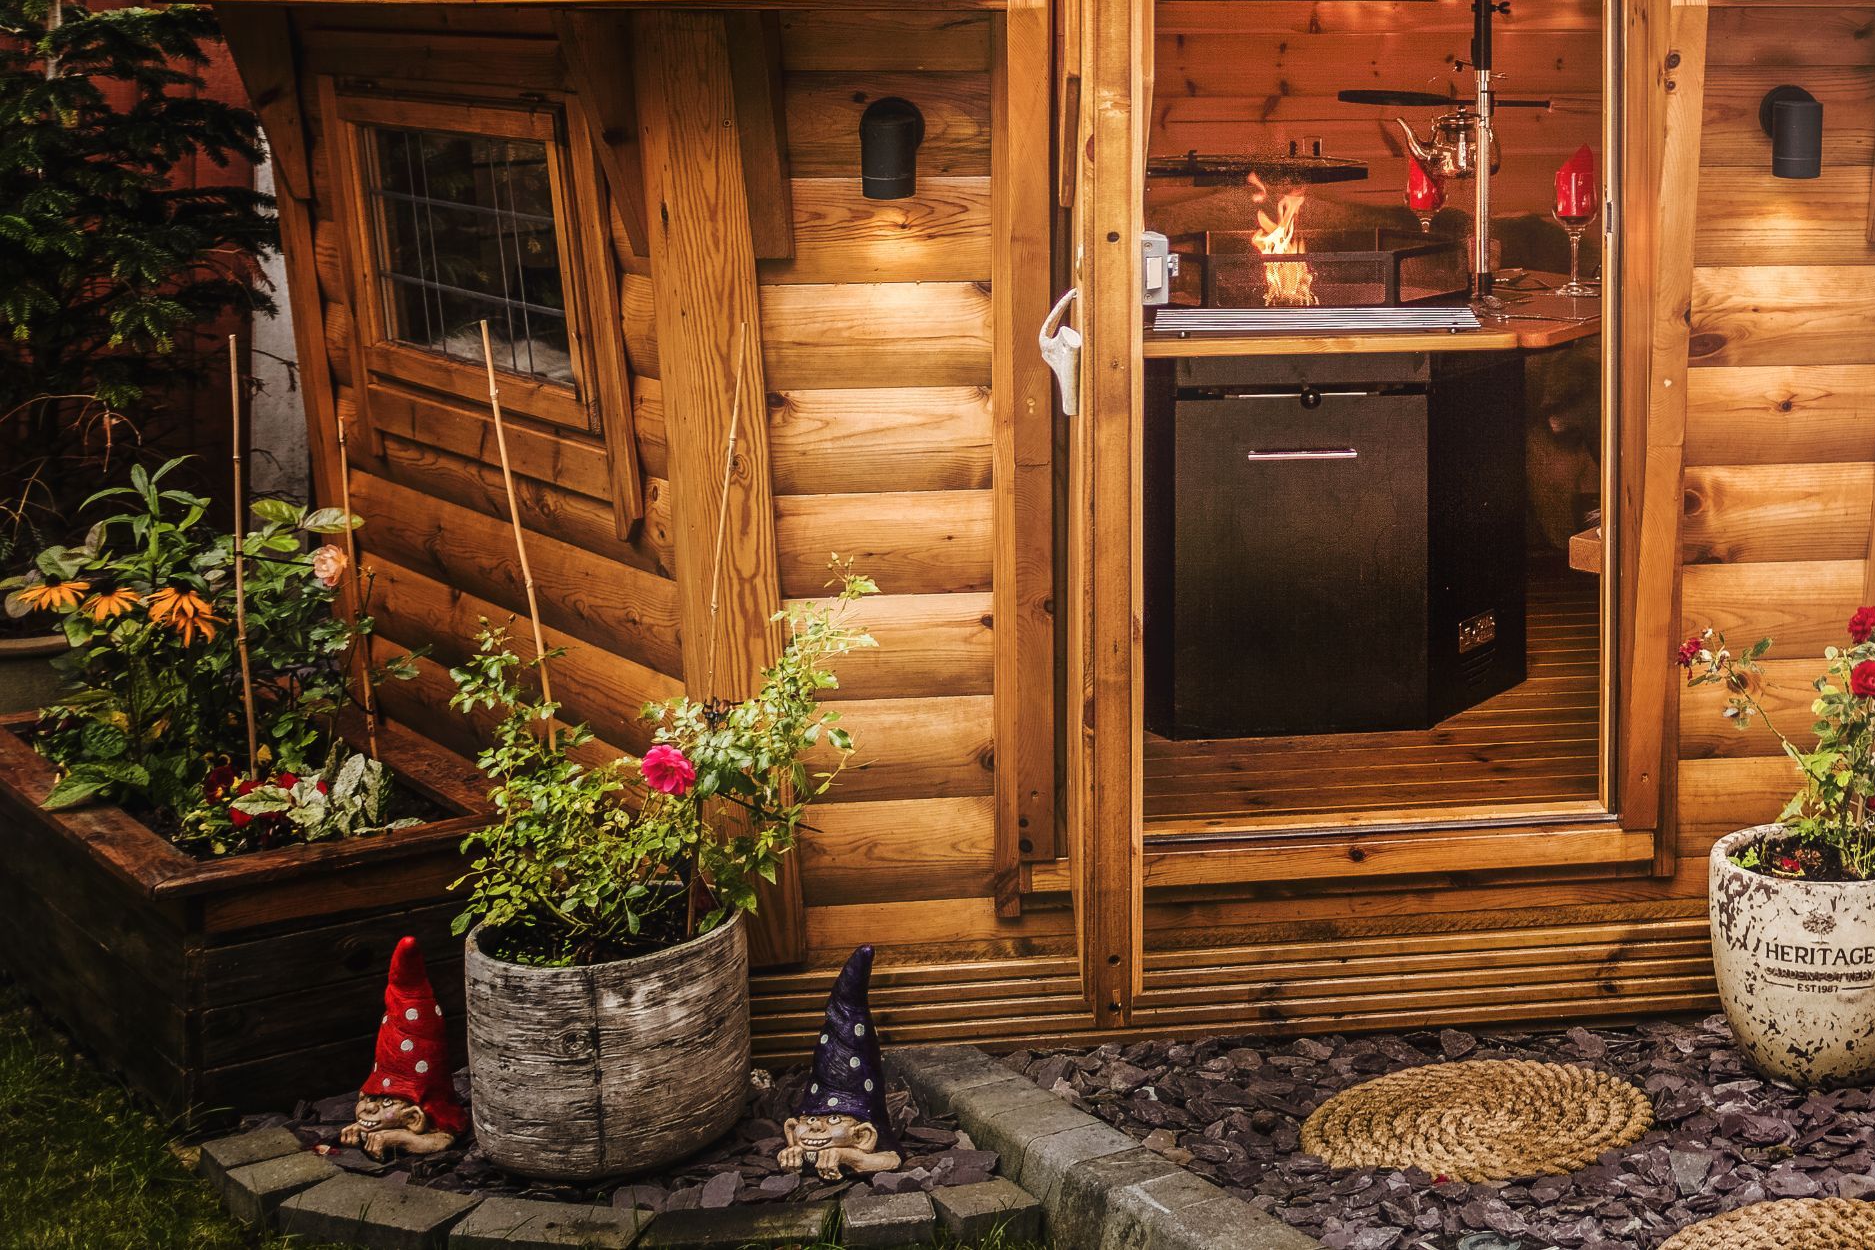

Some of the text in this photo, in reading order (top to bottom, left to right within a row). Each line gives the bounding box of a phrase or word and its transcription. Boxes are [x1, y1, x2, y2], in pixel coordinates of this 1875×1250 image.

[1765, 942, 1875, 965] HERITAGE
[1797, 983, 1839, 994] EST 1987
